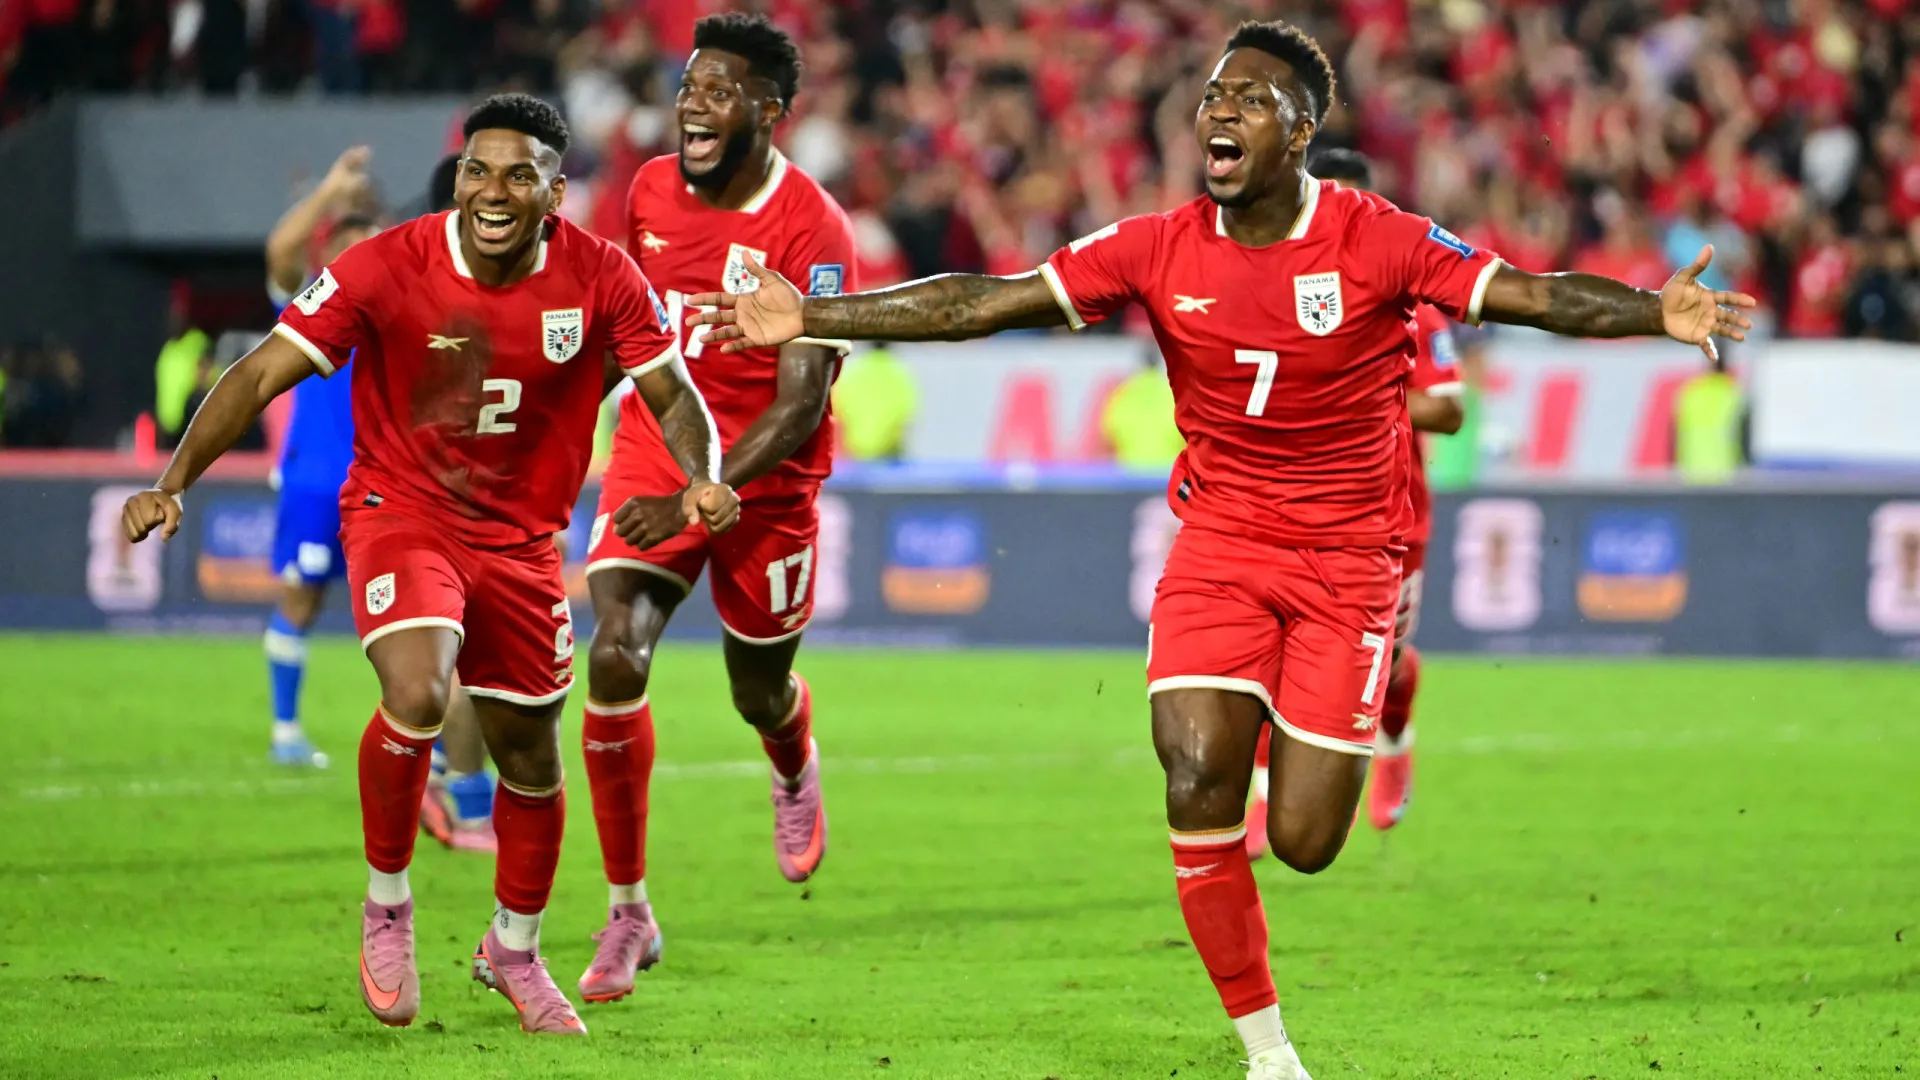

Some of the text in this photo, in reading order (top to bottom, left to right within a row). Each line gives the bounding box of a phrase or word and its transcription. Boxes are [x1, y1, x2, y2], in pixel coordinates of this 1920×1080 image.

[1298, 275, 1335, 286] PANAMA
[545, 311, 579, 320] PANAMA
[477, 379, 522, 434] 2
[1235, 350, 1278, 416] 7
[766, 545, 813, 614] 17
[1361, 631, 1386, 706] 7
